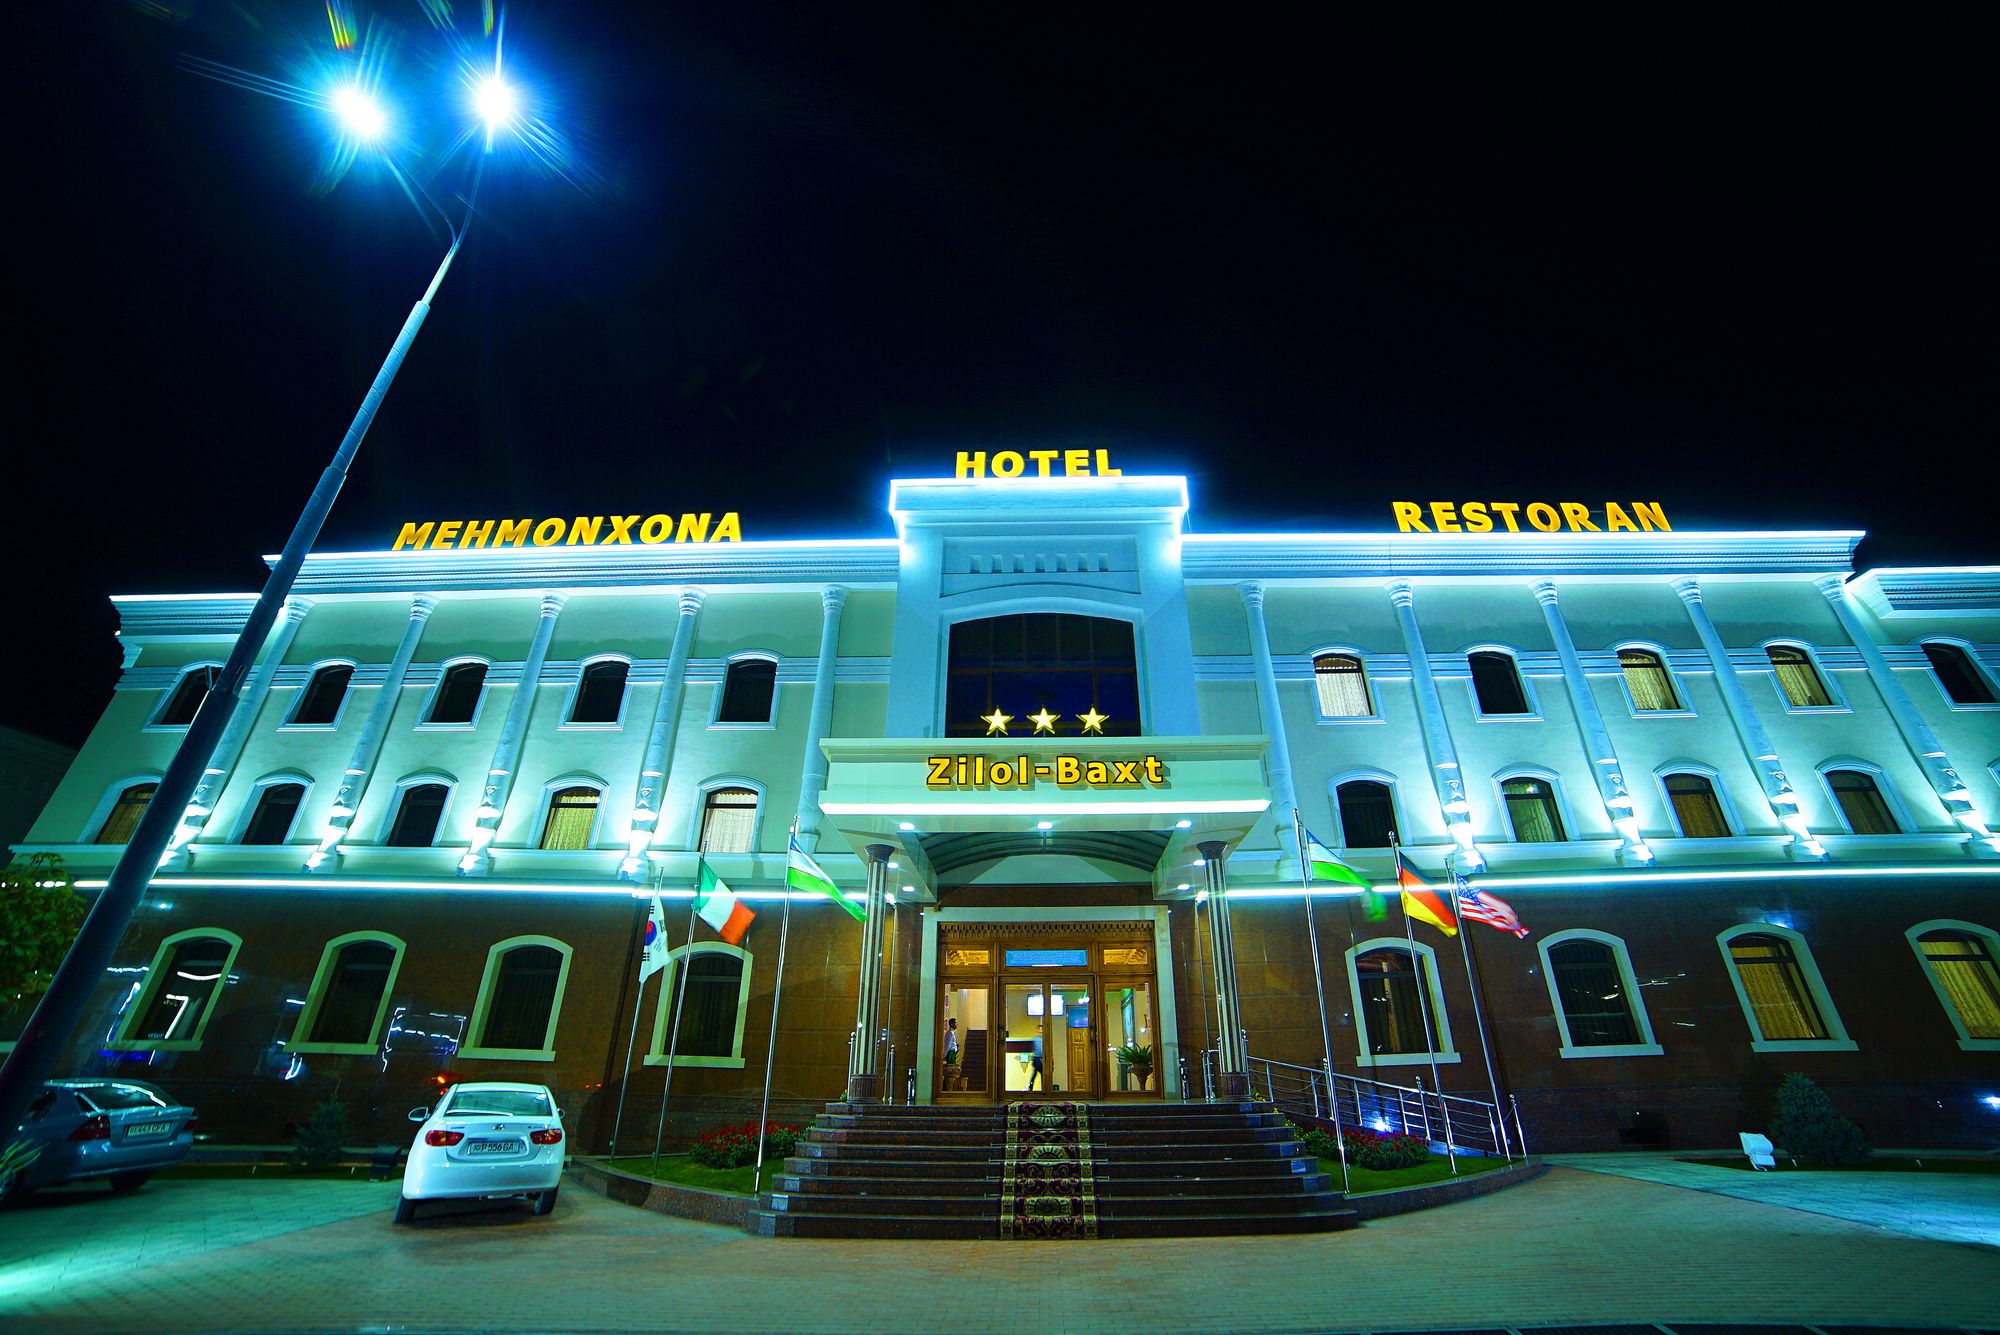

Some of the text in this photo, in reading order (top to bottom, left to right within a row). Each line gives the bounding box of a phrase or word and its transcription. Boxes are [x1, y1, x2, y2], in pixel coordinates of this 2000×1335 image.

[955, 448, 1122, 479] HOTEL
[391, 512, 742, 551] MEHMONXONA
[1392, 501, 1673, 533] RESTORAN
[926, 755, 1165, 786] Zilol-Baxt
